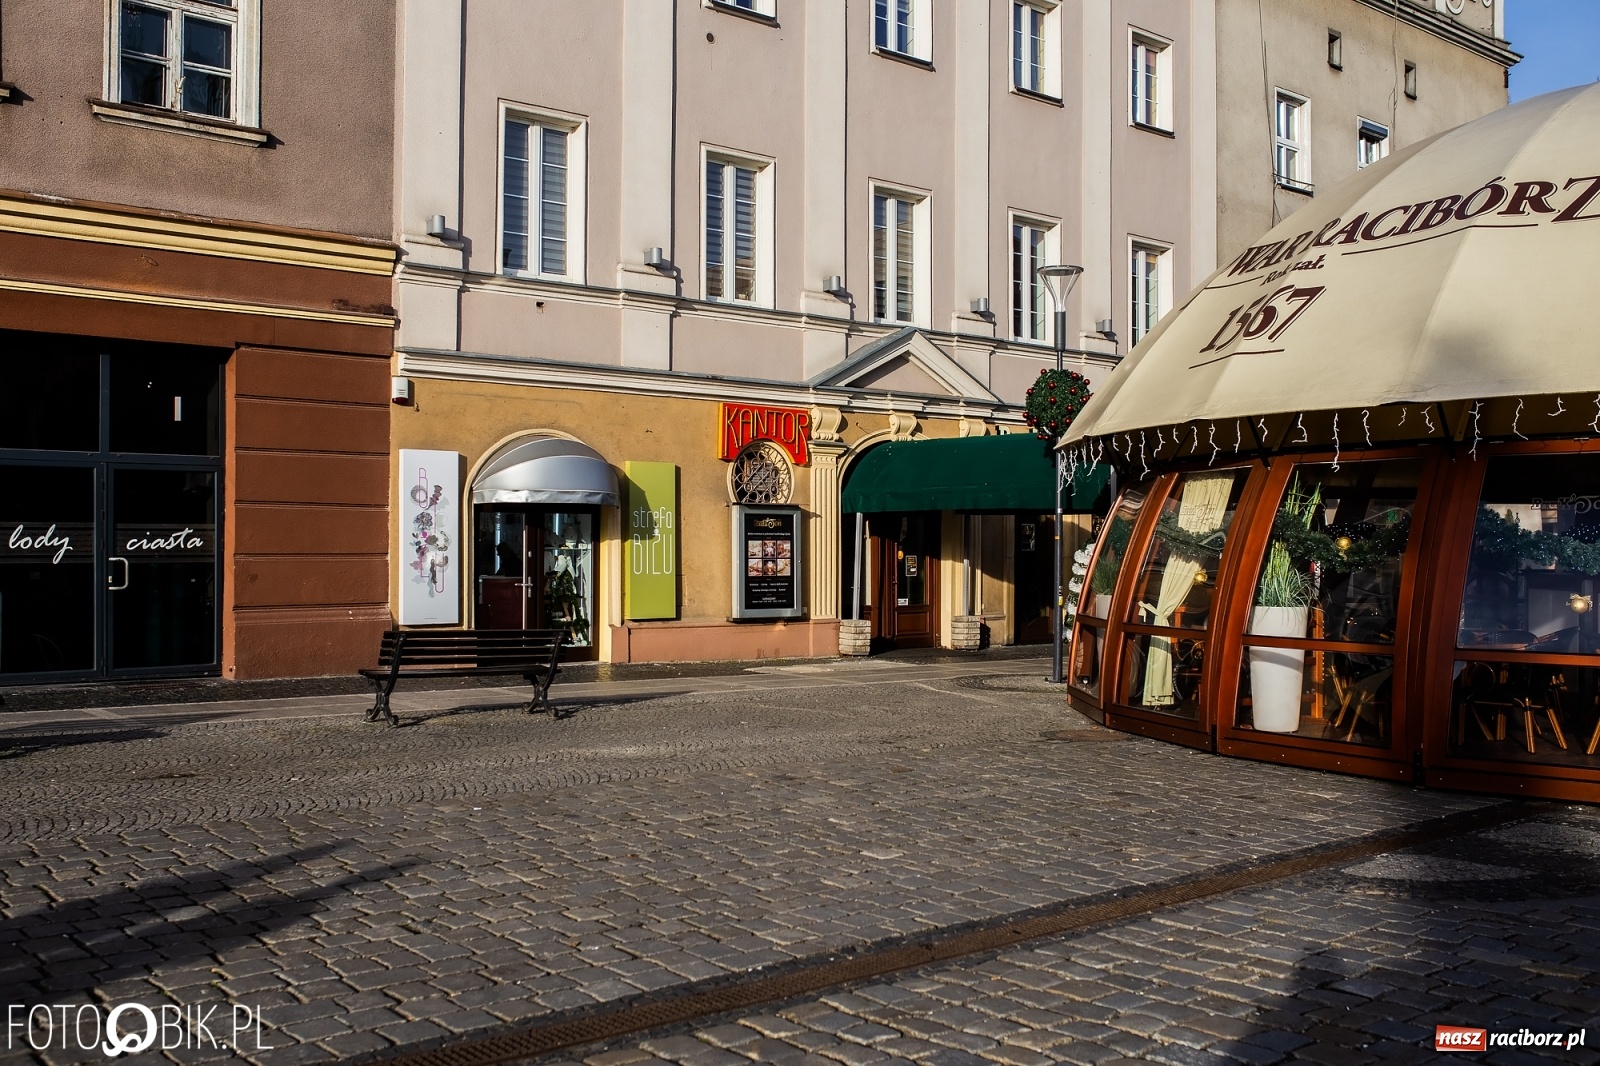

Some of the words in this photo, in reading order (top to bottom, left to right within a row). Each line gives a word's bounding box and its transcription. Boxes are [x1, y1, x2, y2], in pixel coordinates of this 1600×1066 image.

[1199, 285, 1327, 354] 1567
[724, 406, 809, 462] KANTOR
[633, 506, 672, 528] strefa
[8, 523, 74, 565] lody
[126, 527, 204, 551] ciasta
